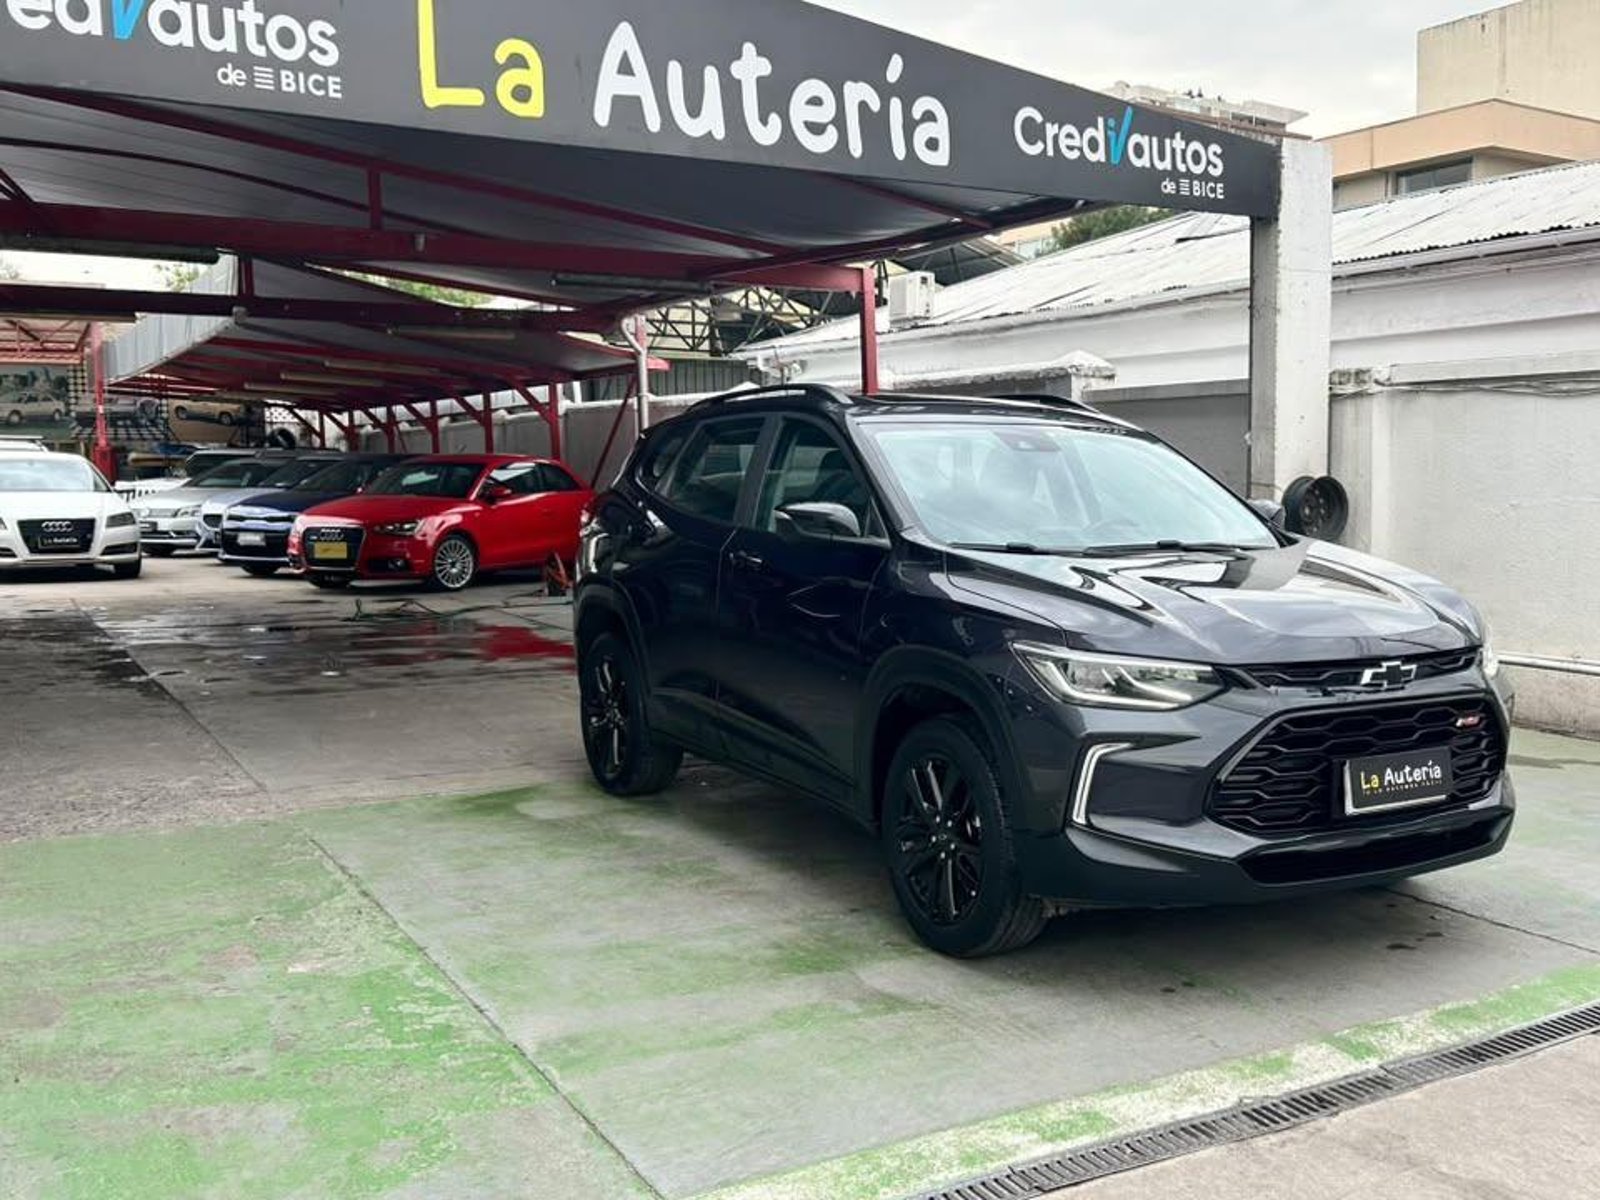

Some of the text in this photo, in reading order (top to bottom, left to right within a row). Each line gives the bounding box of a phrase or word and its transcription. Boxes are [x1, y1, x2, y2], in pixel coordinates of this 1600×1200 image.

[216, 62, 344, 99] de BICE
[417, 0, 951, 168] La Autería
[1160, 177, 1225, 200] de BICE
[1360, 771, 1379, 790] La
[1383, 760, 1442, 786] Autería
